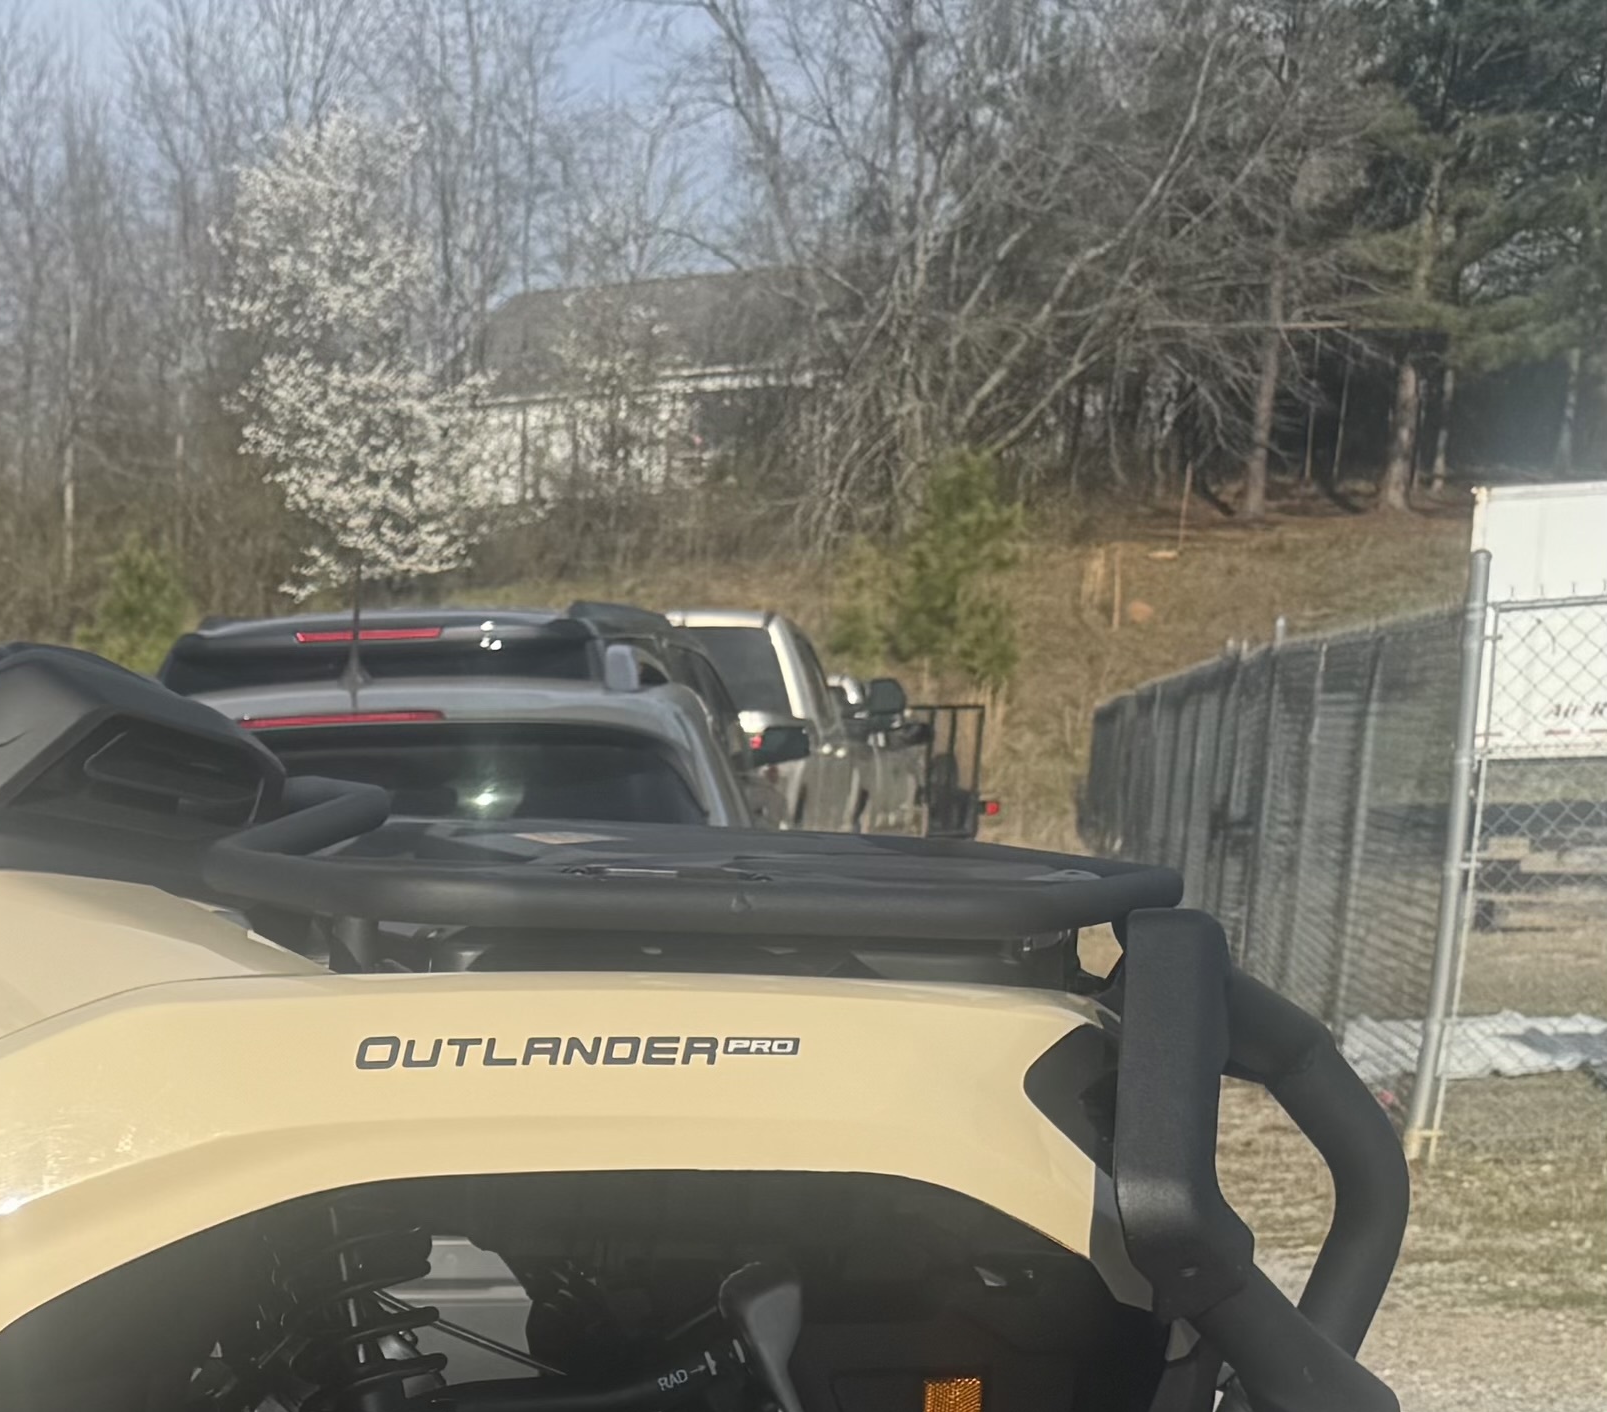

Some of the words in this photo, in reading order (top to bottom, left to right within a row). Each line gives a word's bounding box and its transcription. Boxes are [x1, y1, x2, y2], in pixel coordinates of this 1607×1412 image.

[355, 1036, 719, 1070] OUTLANDER
[726, 1039, 795, 1054] PRO
[657, 1368, 689, 1392] RAD
